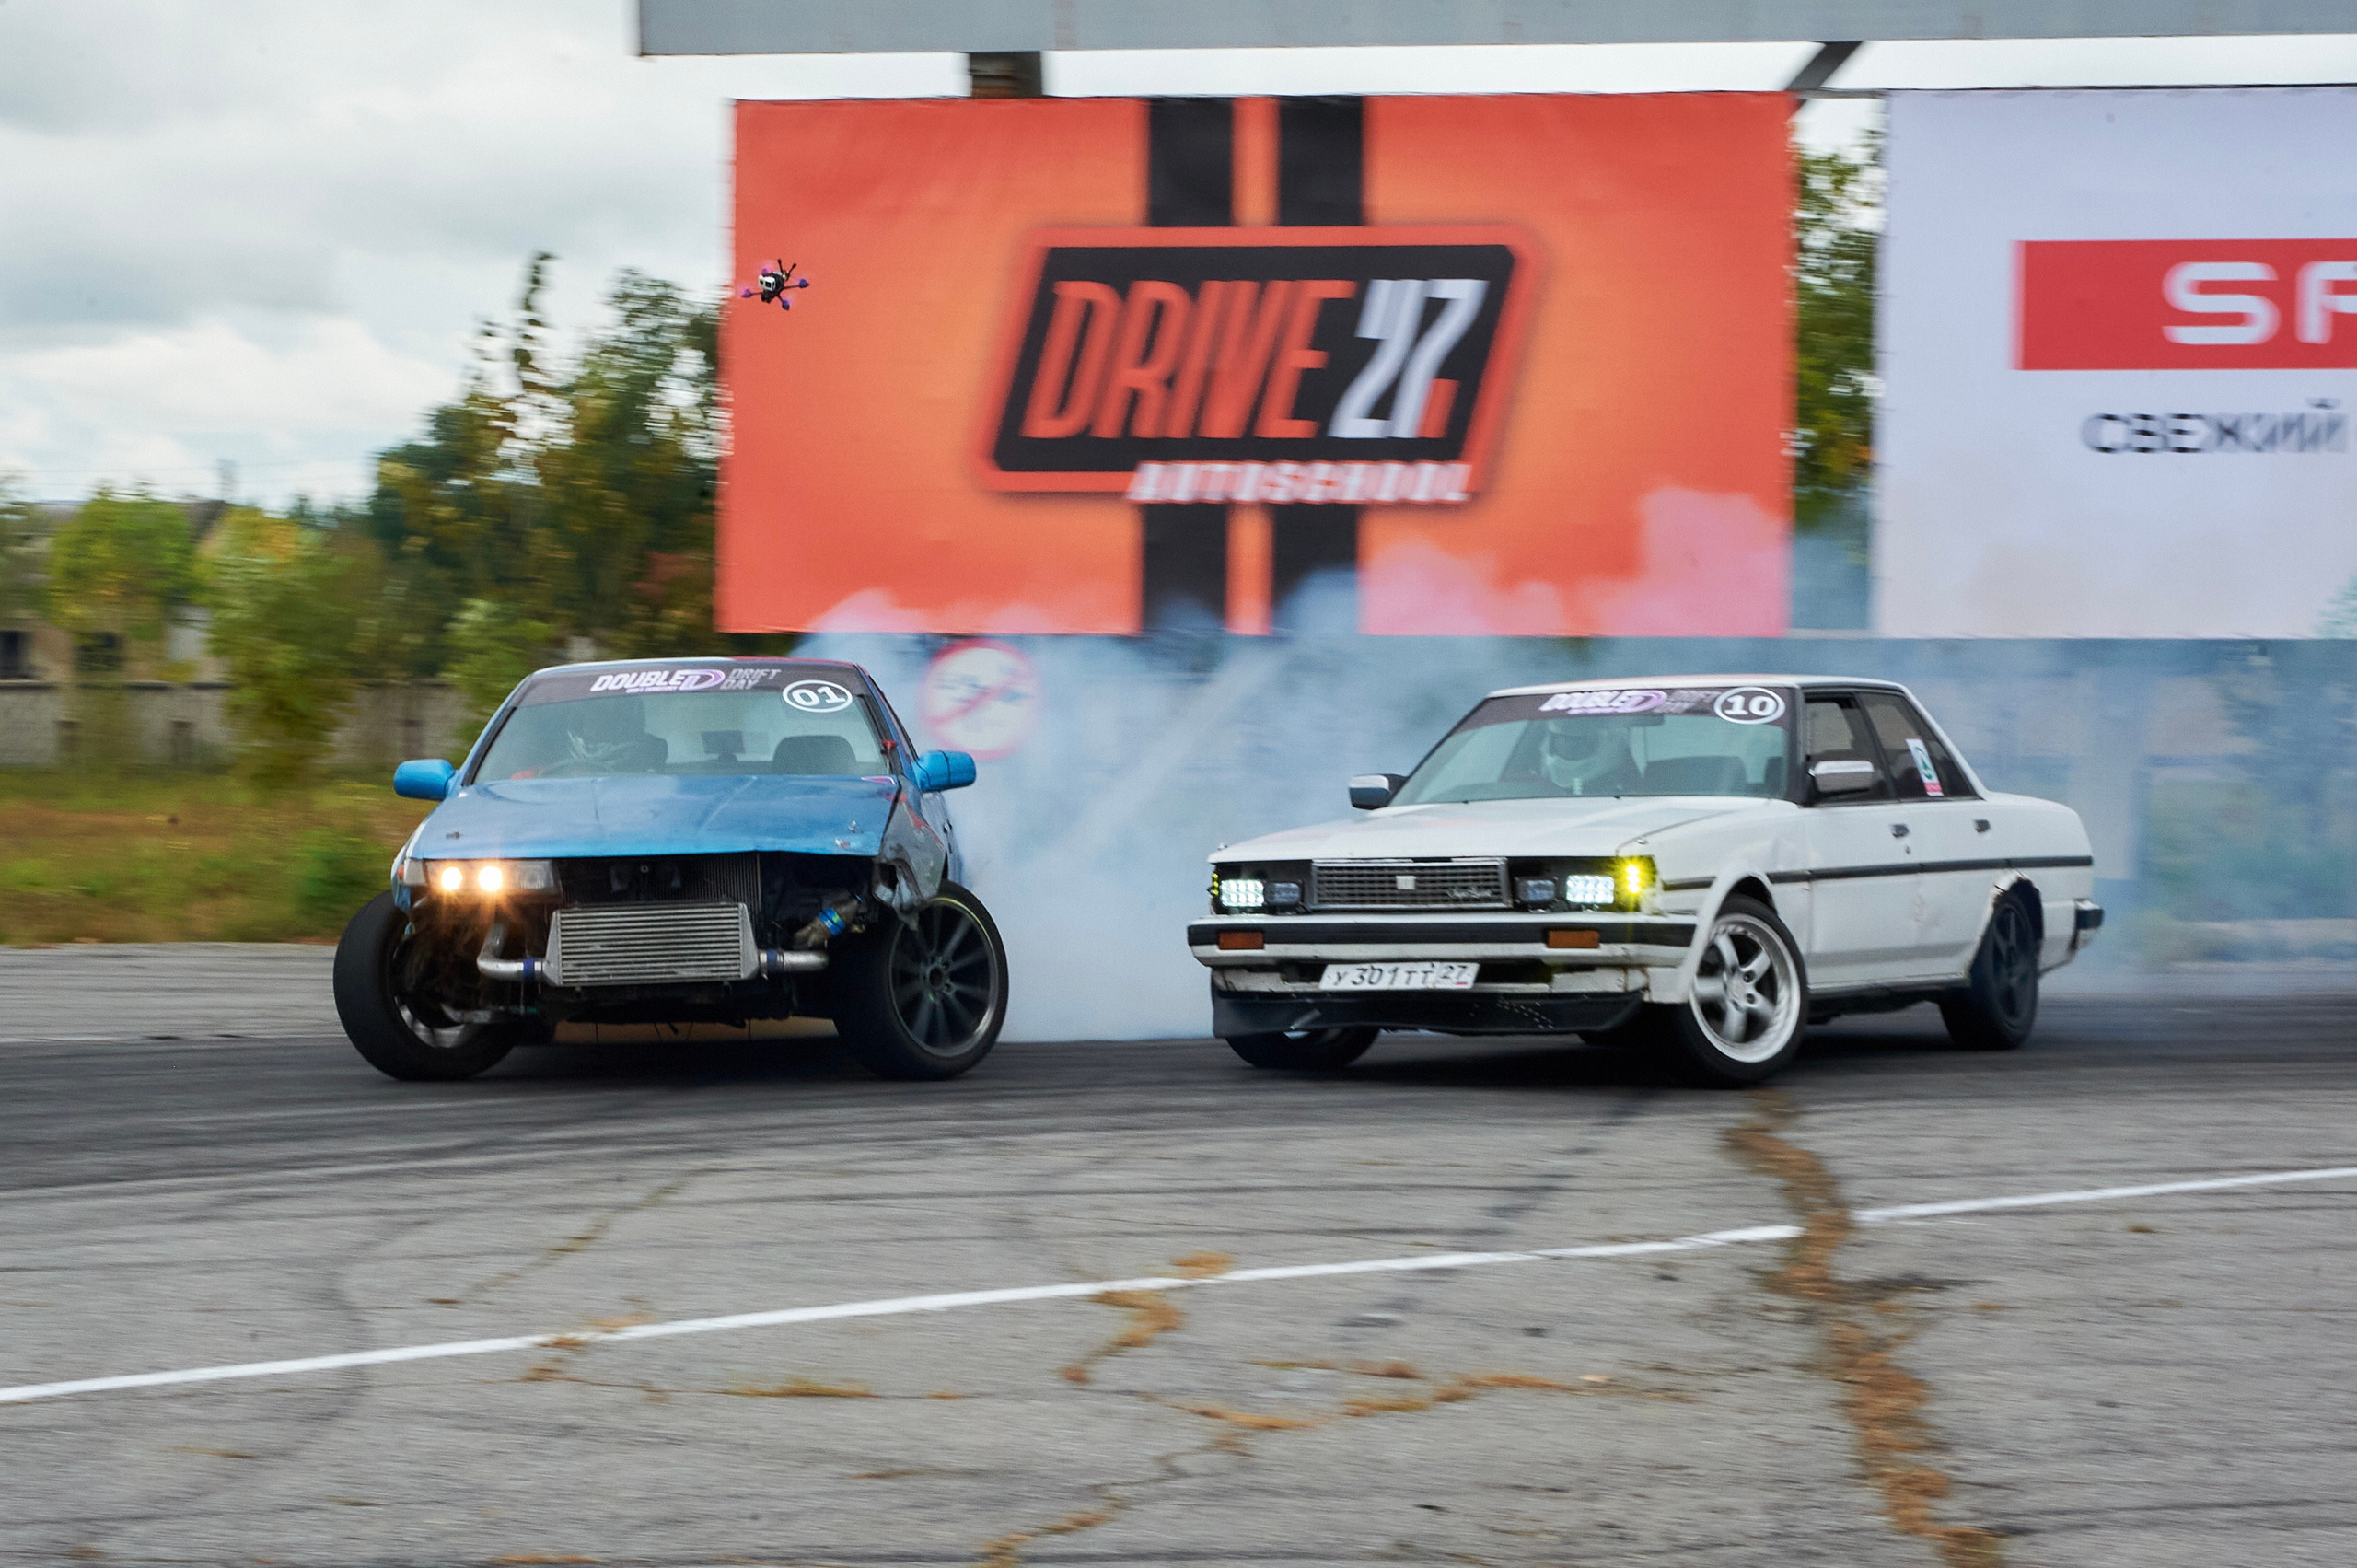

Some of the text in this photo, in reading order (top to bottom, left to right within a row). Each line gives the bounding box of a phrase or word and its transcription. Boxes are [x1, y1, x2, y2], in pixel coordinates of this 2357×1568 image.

[1020, 280, 1357, 438] DRIVE
[728, 668, 782, 680] DRIFT
[719, 679, 760, 691] DAY
[792, 686, 846, 707] 01
[1724, 694, 1778, 716] 10
